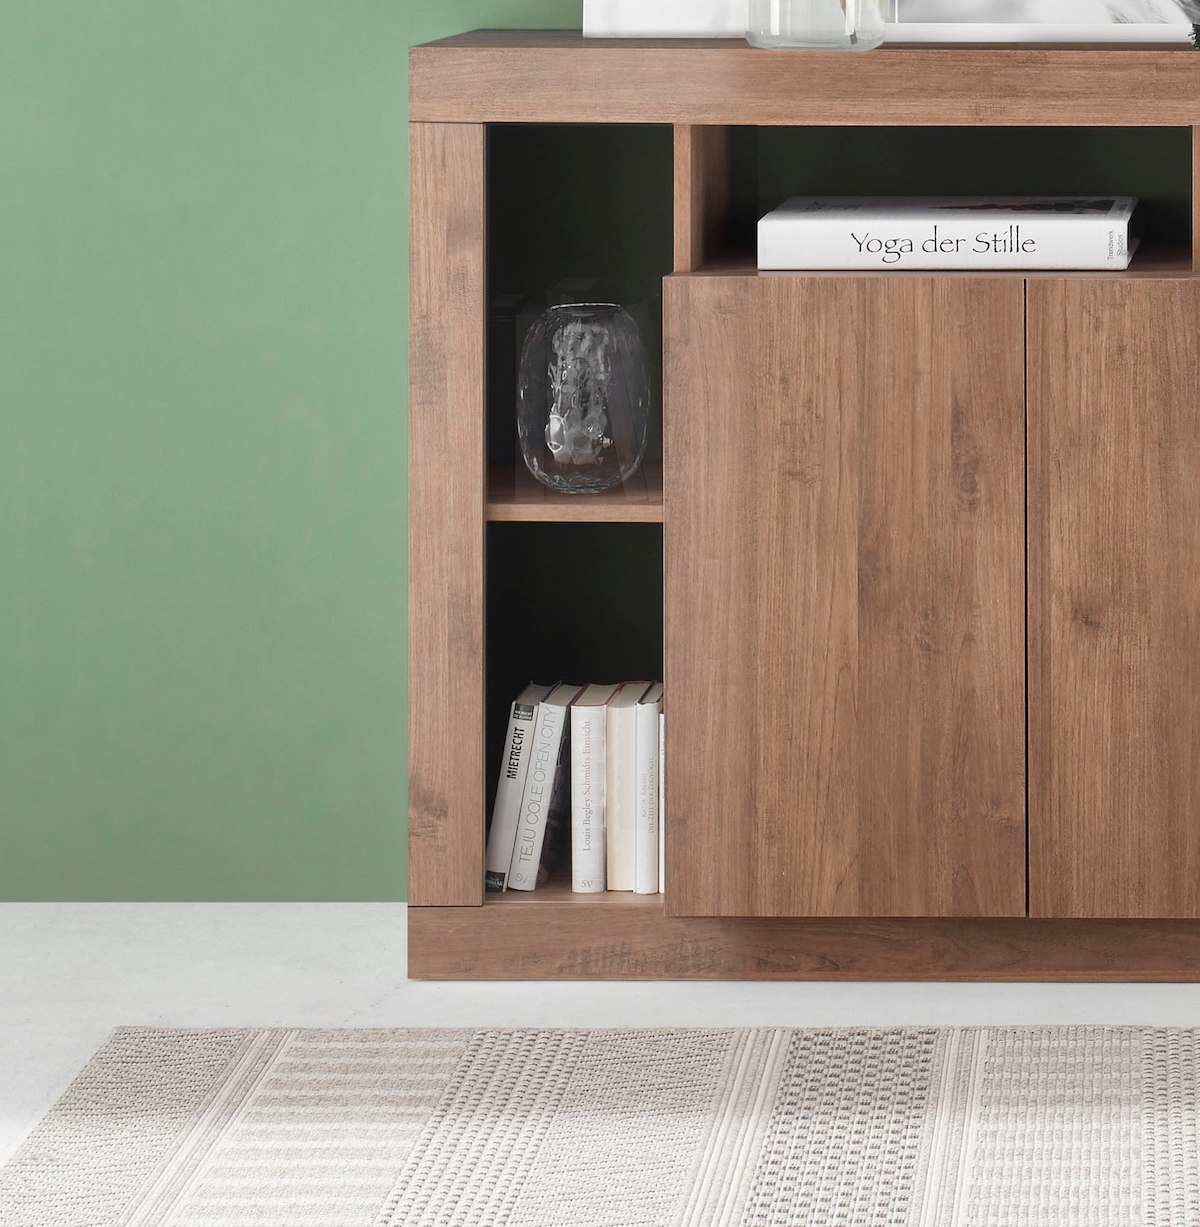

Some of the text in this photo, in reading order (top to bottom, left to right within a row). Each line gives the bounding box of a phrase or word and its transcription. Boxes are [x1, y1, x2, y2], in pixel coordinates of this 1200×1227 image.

[850, 225, 1036, 263] Yoga der Stille
[506, 726, 525, 780] MIETRECHT
[582, 721, 590, 754] Einsicht
[518, 706, 556, 864] TEJU COLE OPEN CITY
[582, 757, 591, 795] Schmidts
[583, 797, 593, 825] Begley
[581, 879, 593, 888] SV
